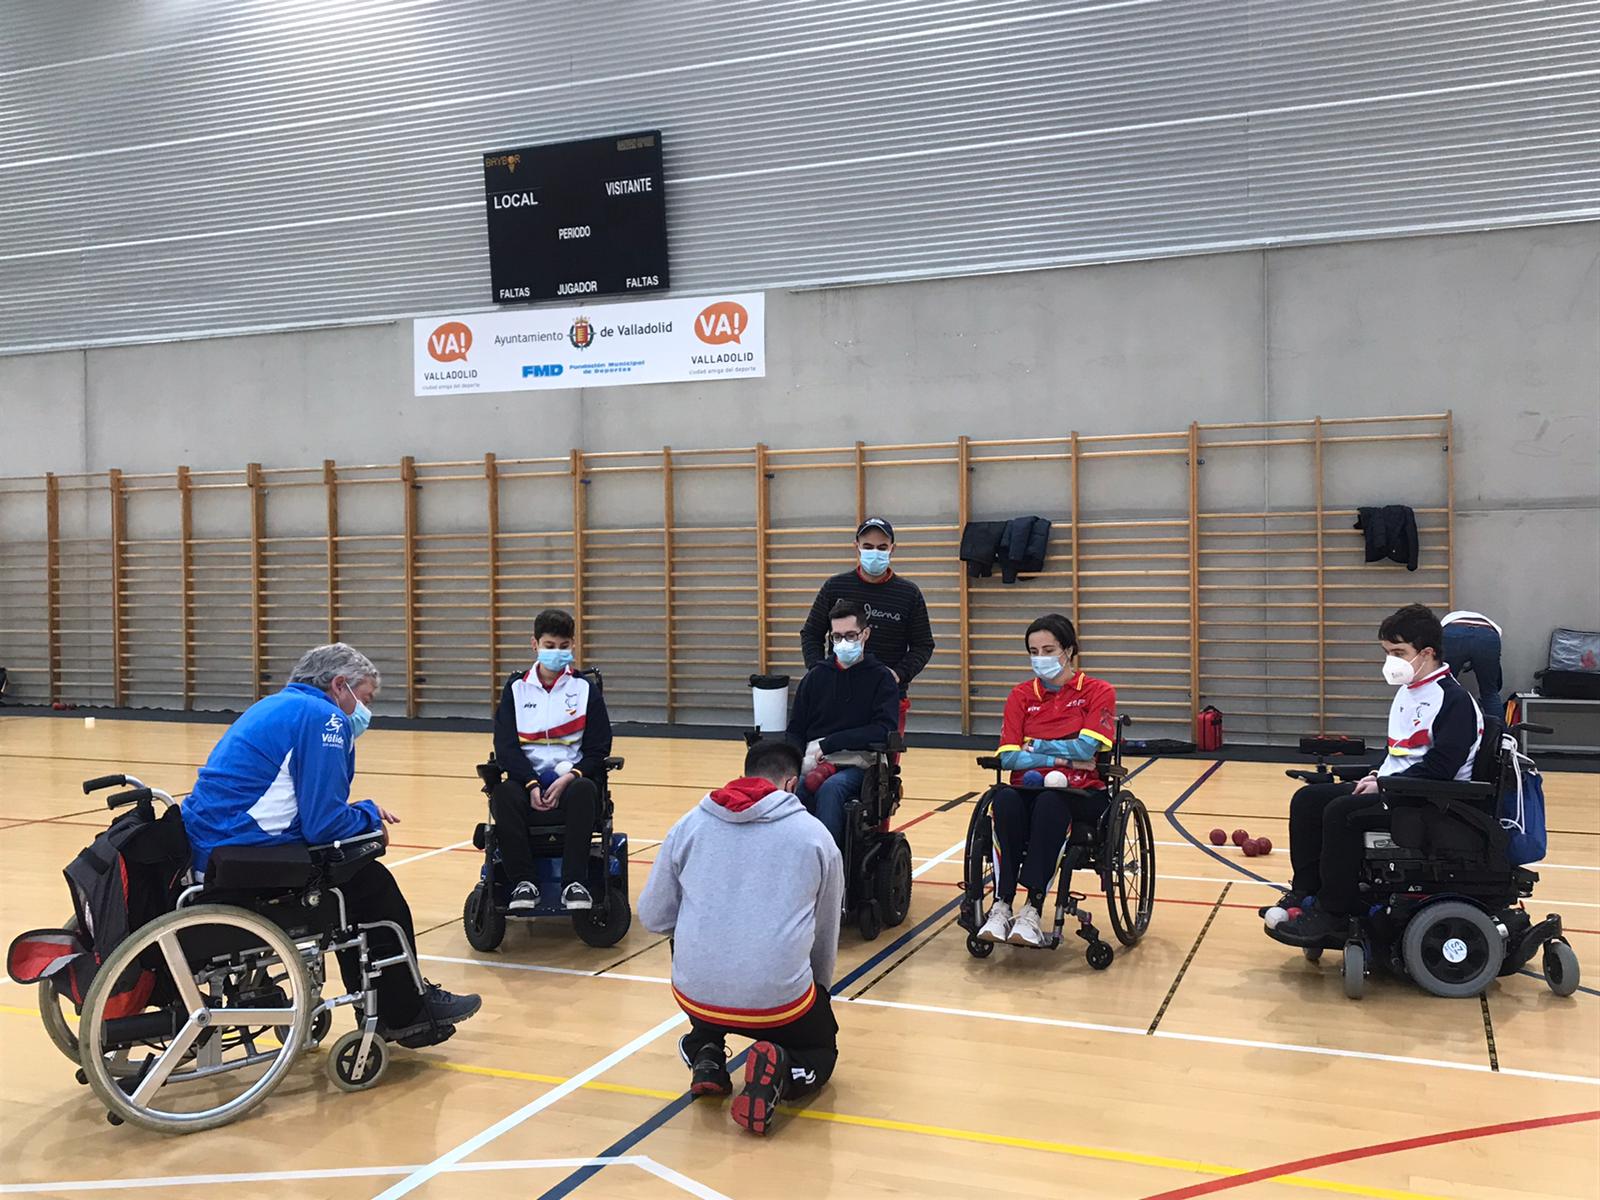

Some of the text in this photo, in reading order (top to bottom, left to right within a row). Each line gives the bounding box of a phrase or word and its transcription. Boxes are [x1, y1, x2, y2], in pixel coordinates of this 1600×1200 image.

[605, 177, 653, 196] VISITANTE
[493, 191, 539, 209] LOCAL
[558, 225, 591, 240] PERIODO
[557, 280, 598, 295] JUGADOR
[626, 275, 659, 289] FALTAS
[499, 287, 530, 299] FALTAS
[699, 312, 740, 337] VA!
[494, 321, 673, 346] Ayuntamiento de Valladolid
[431, 332, 466, 355] VA!
[691, 352, 754, 364] VALLADOLID
[424, 369, 478, 381] VALLADOLID
[522, 364, 564, 378] FMD
